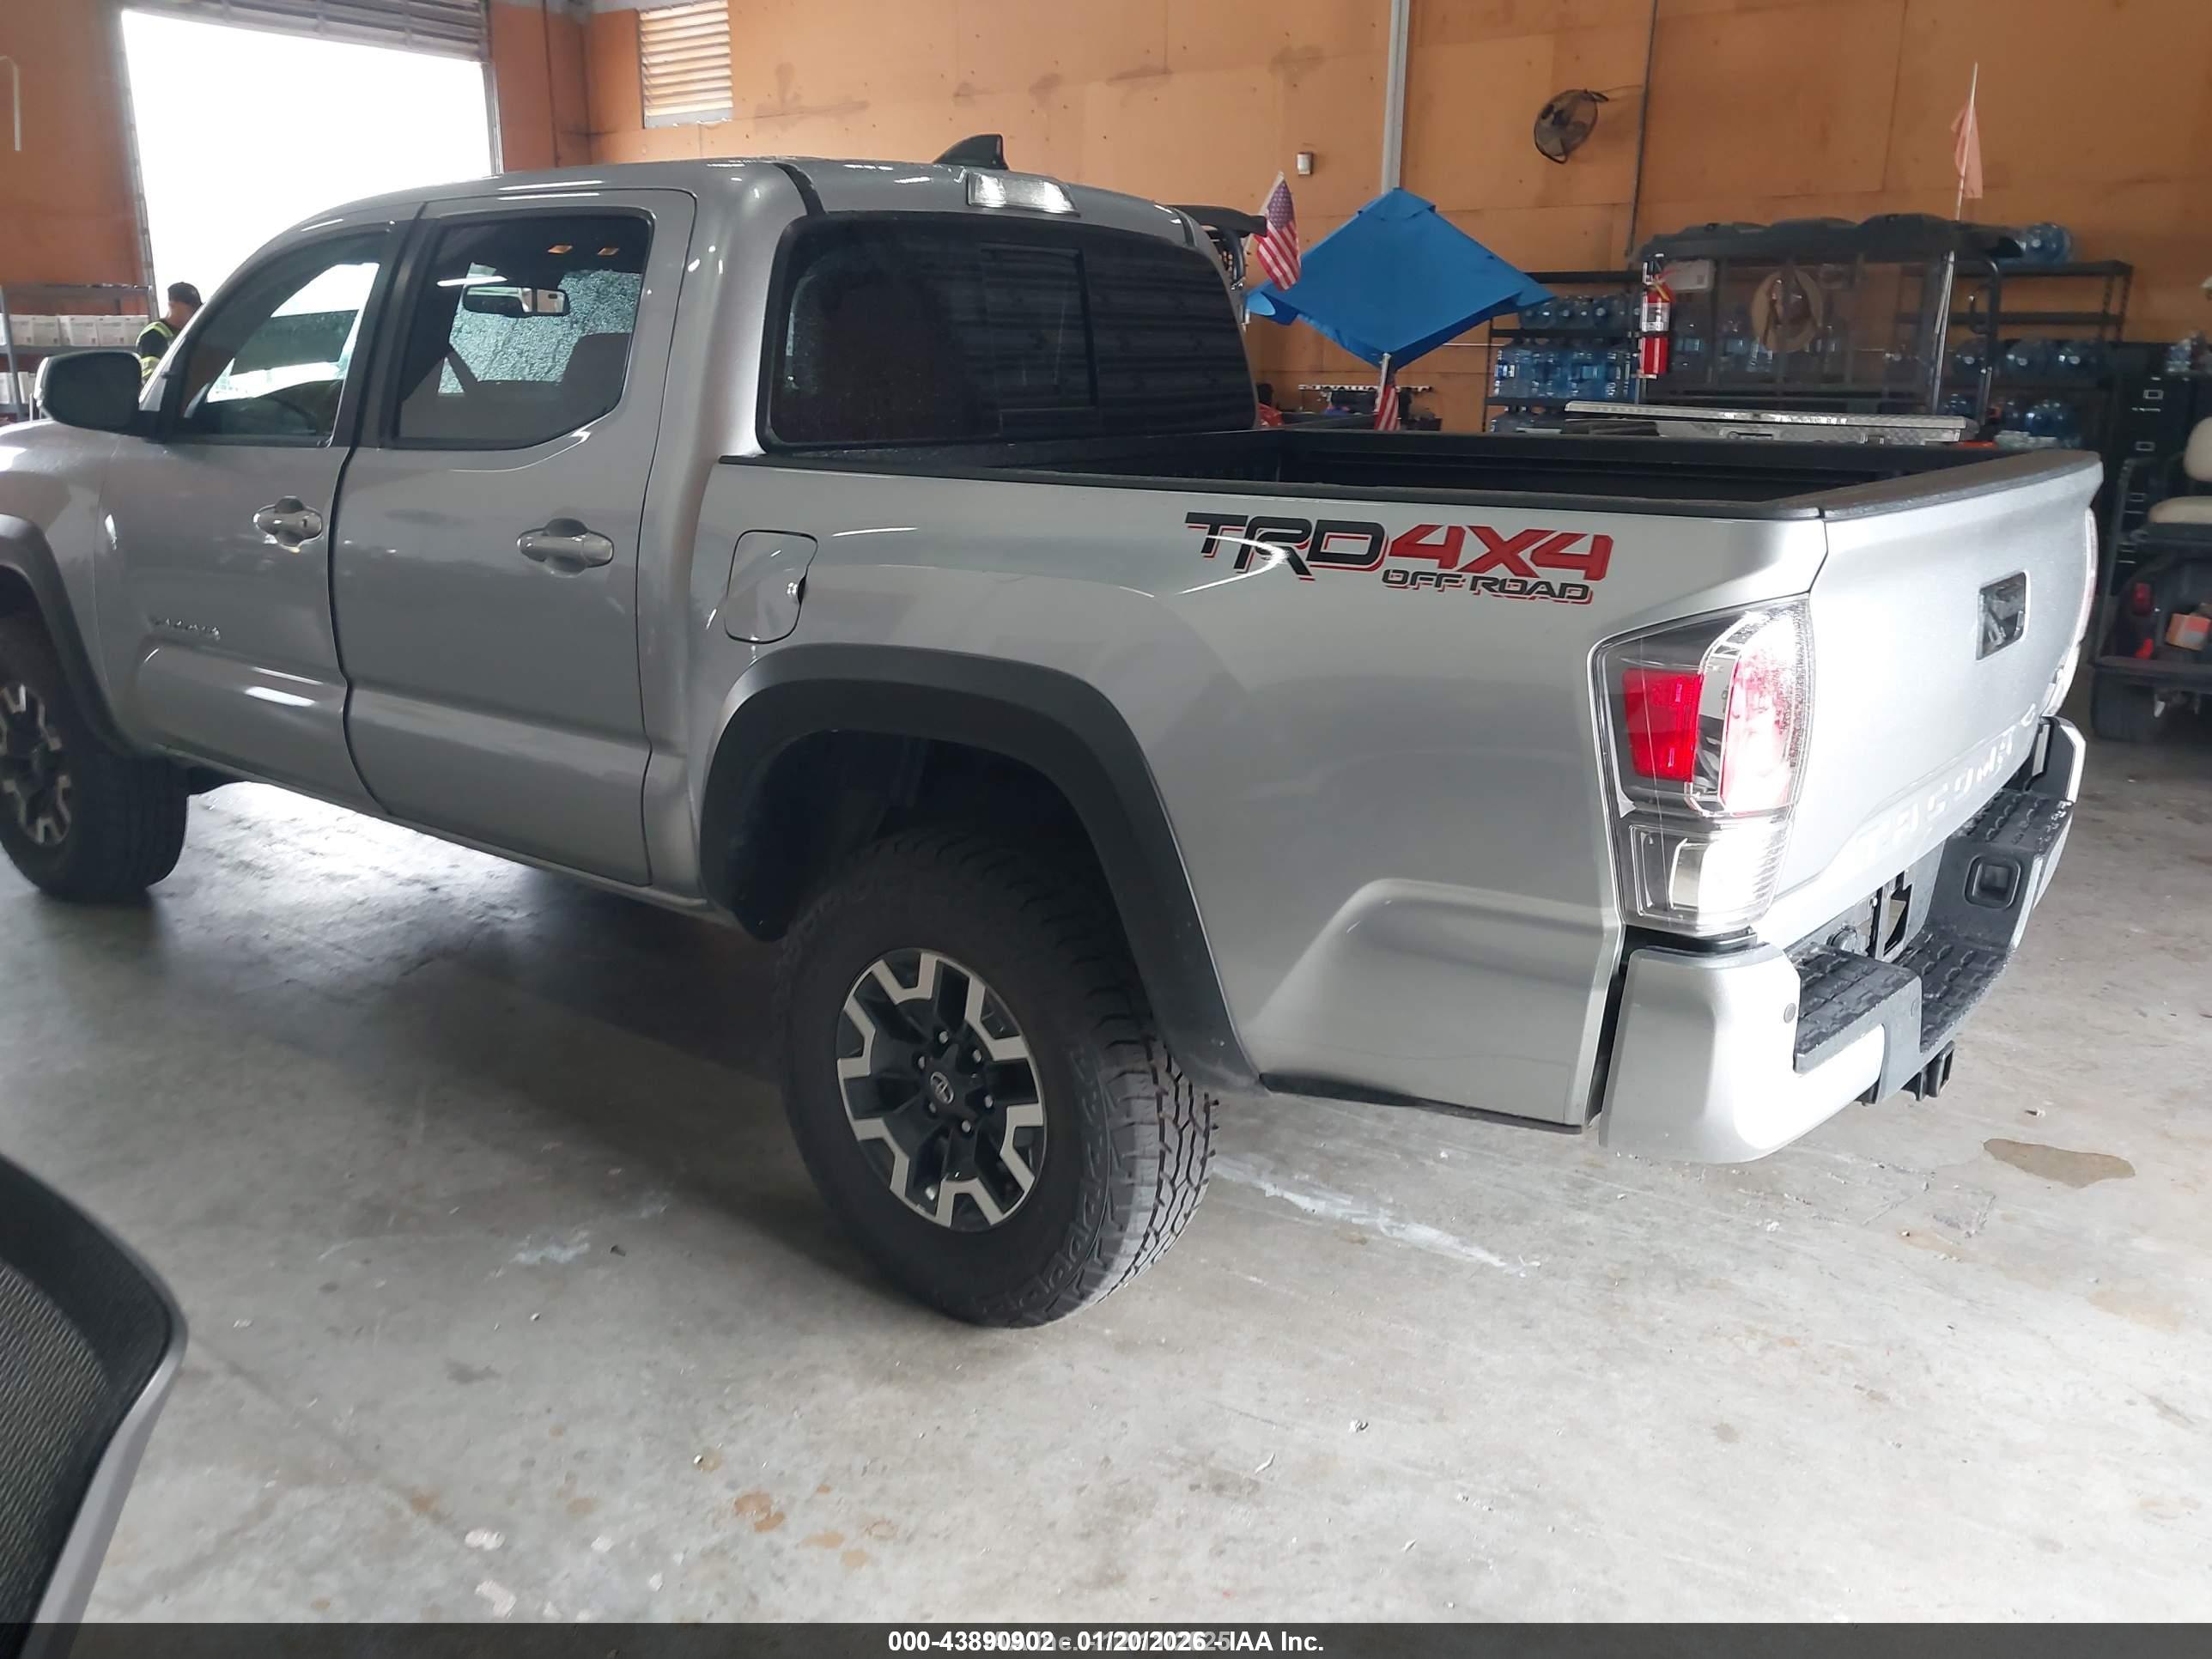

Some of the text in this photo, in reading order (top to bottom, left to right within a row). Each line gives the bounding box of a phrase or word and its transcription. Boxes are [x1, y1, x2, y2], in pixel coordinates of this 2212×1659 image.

[1185, 512, 1613, 581] TRD 4X4
[1382, 568, 1594, 605] OFF ROAD
